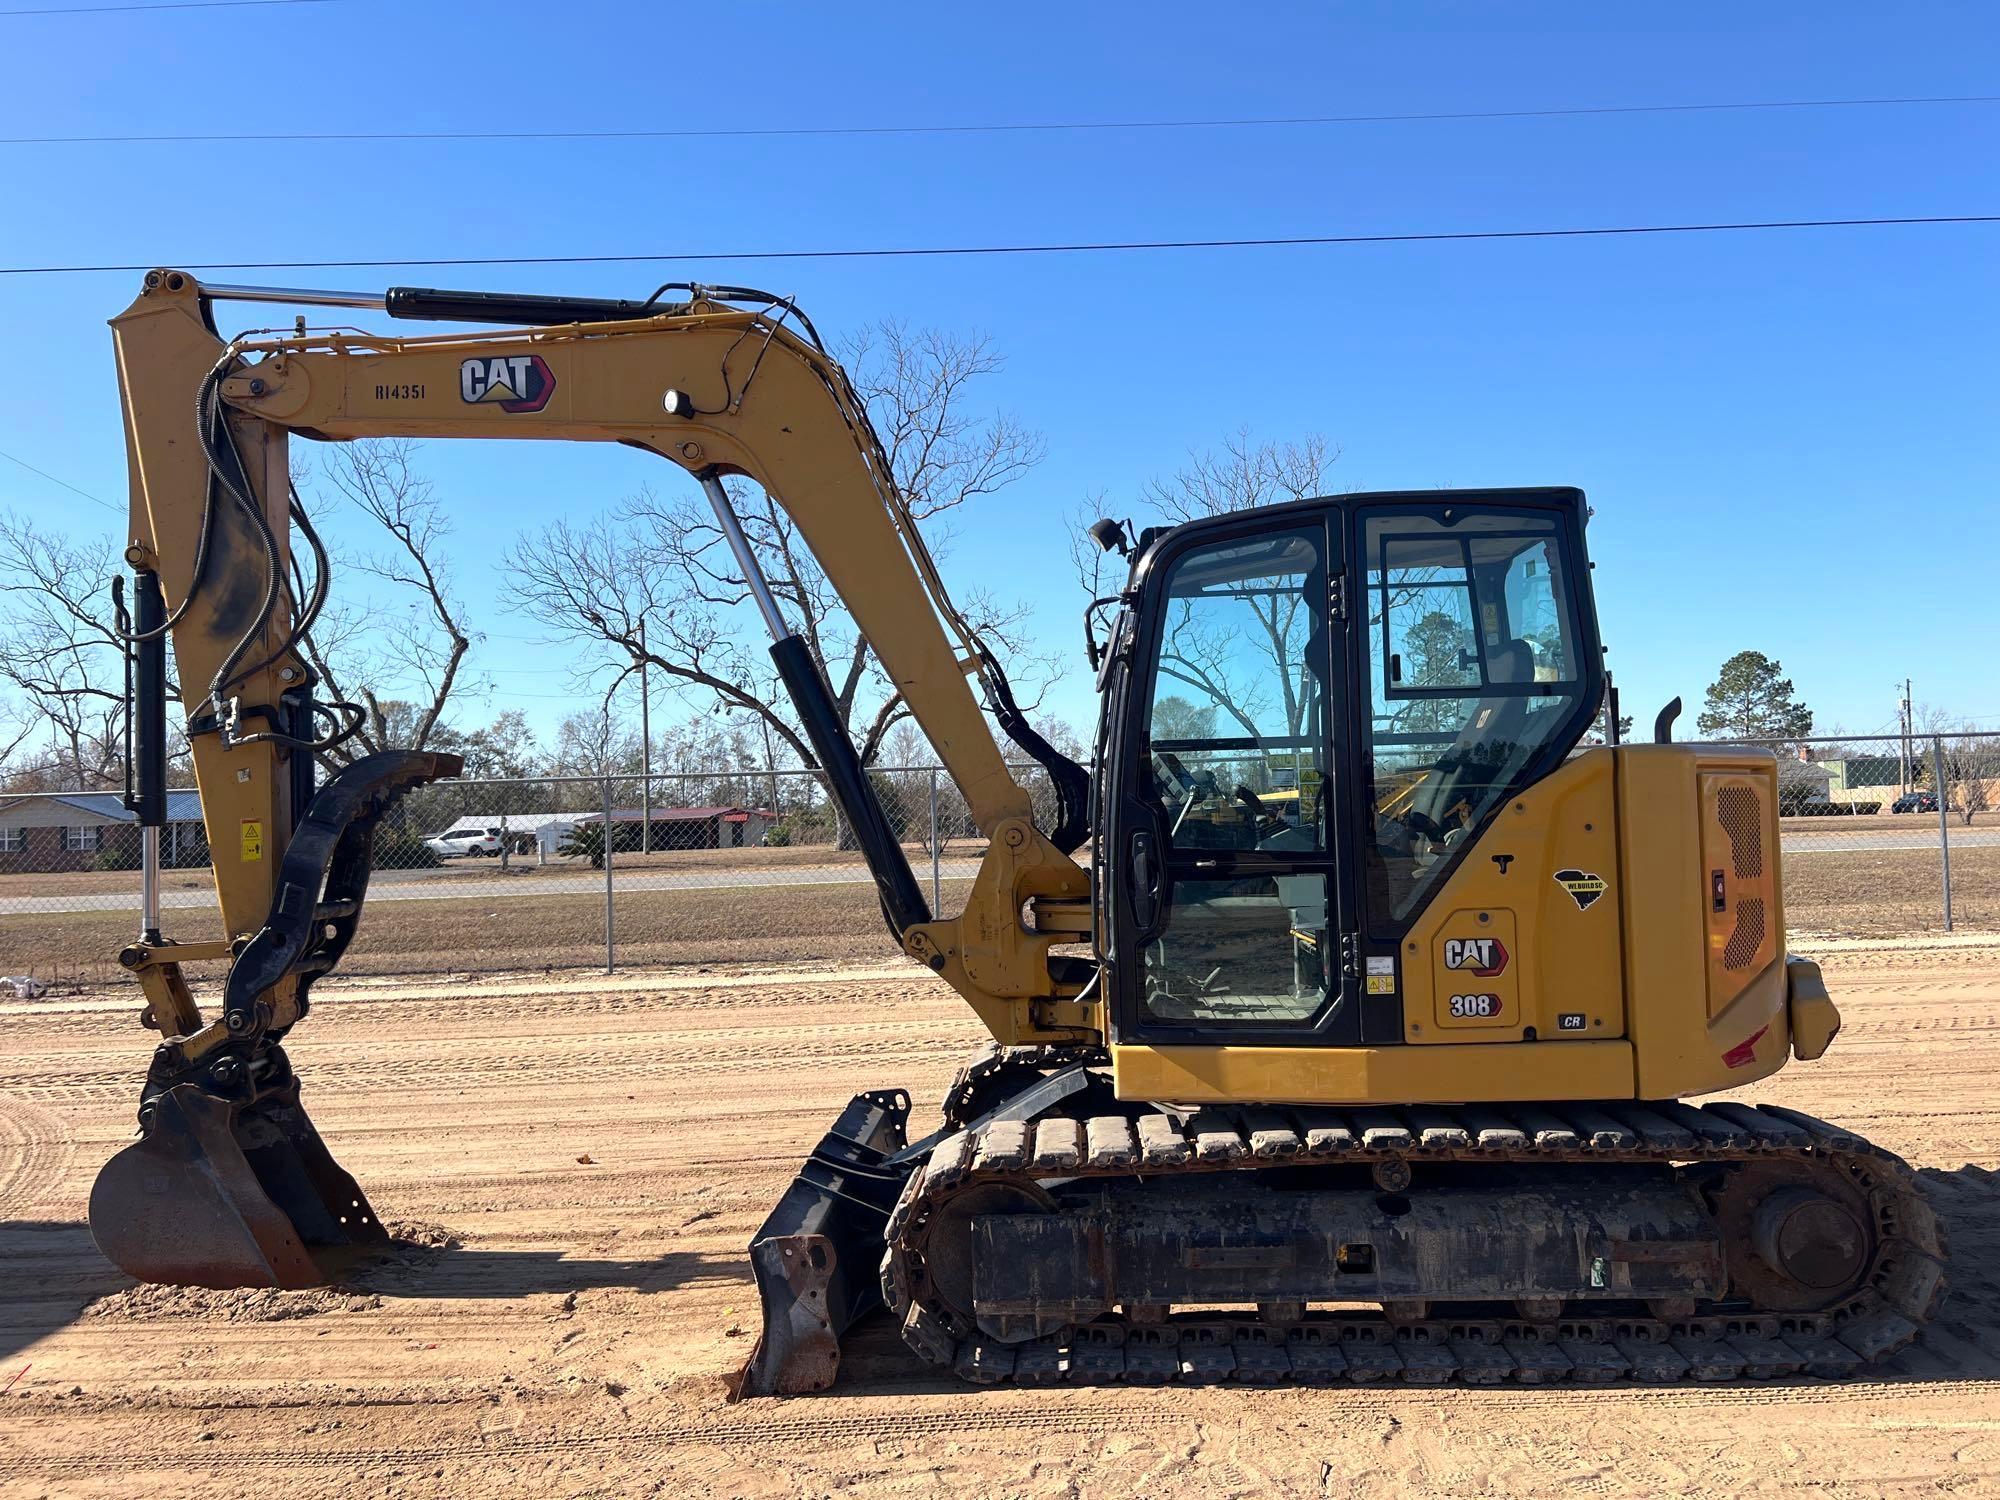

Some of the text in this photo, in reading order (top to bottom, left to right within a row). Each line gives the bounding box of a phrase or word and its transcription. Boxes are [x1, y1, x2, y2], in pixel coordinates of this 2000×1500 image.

[461, 356, 532, 402] CAT
[1577, 882, 1595, 890] BUILD
[1445, 939, 1493, 969] CAT
[1450, 995, 1491, 1017] 308
[1564, 1016, 1581, 1028] CR
